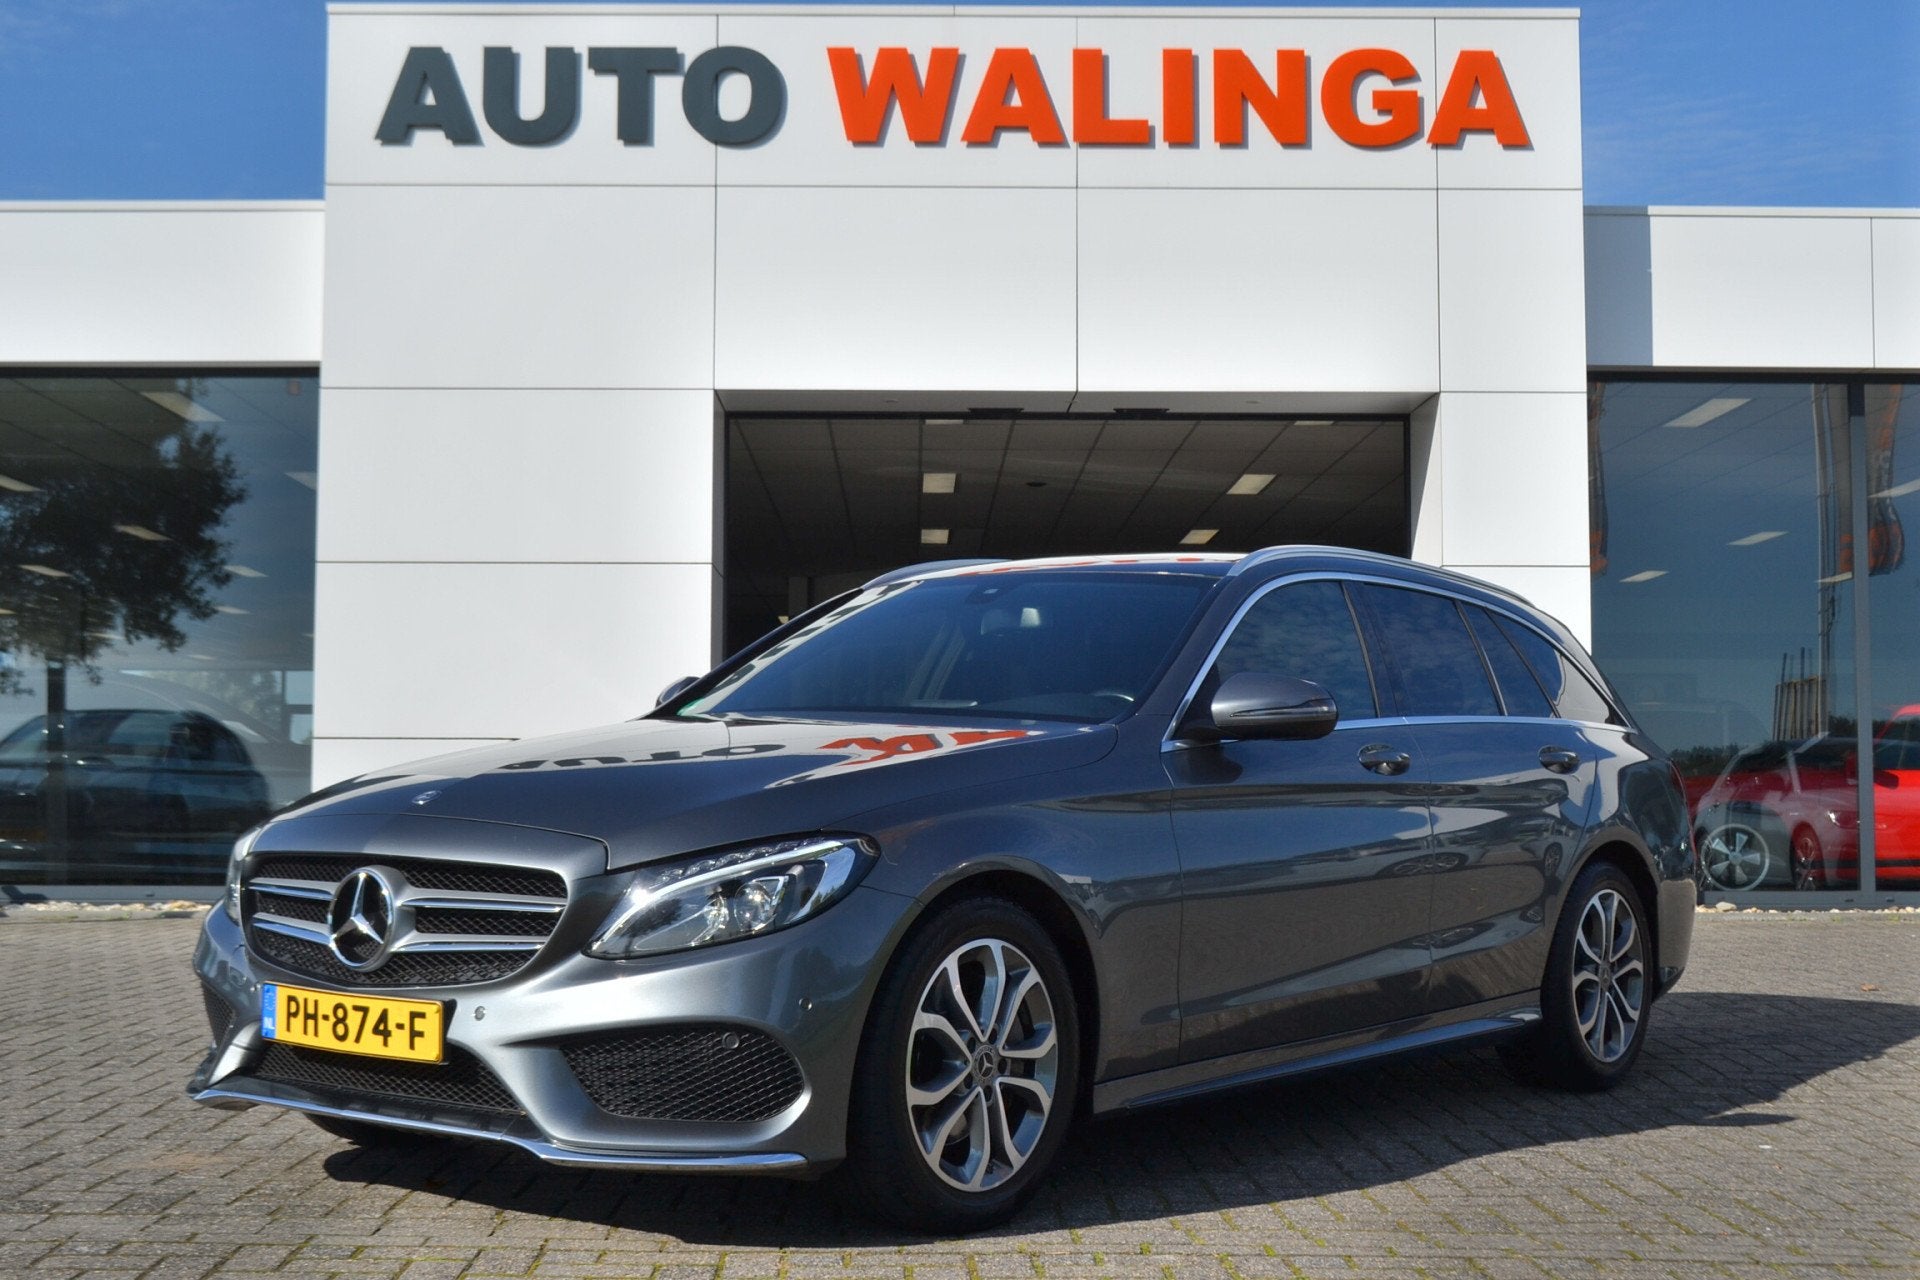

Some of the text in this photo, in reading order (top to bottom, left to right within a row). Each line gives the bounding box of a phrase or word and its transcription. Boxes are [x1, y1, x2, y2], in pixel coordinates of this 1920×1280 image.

[375, 46, 1530, 148] AUTO WALINGA
[263, 1016, 276, 1031] NL
[286, 995, 427, 1050] PH-874-F
